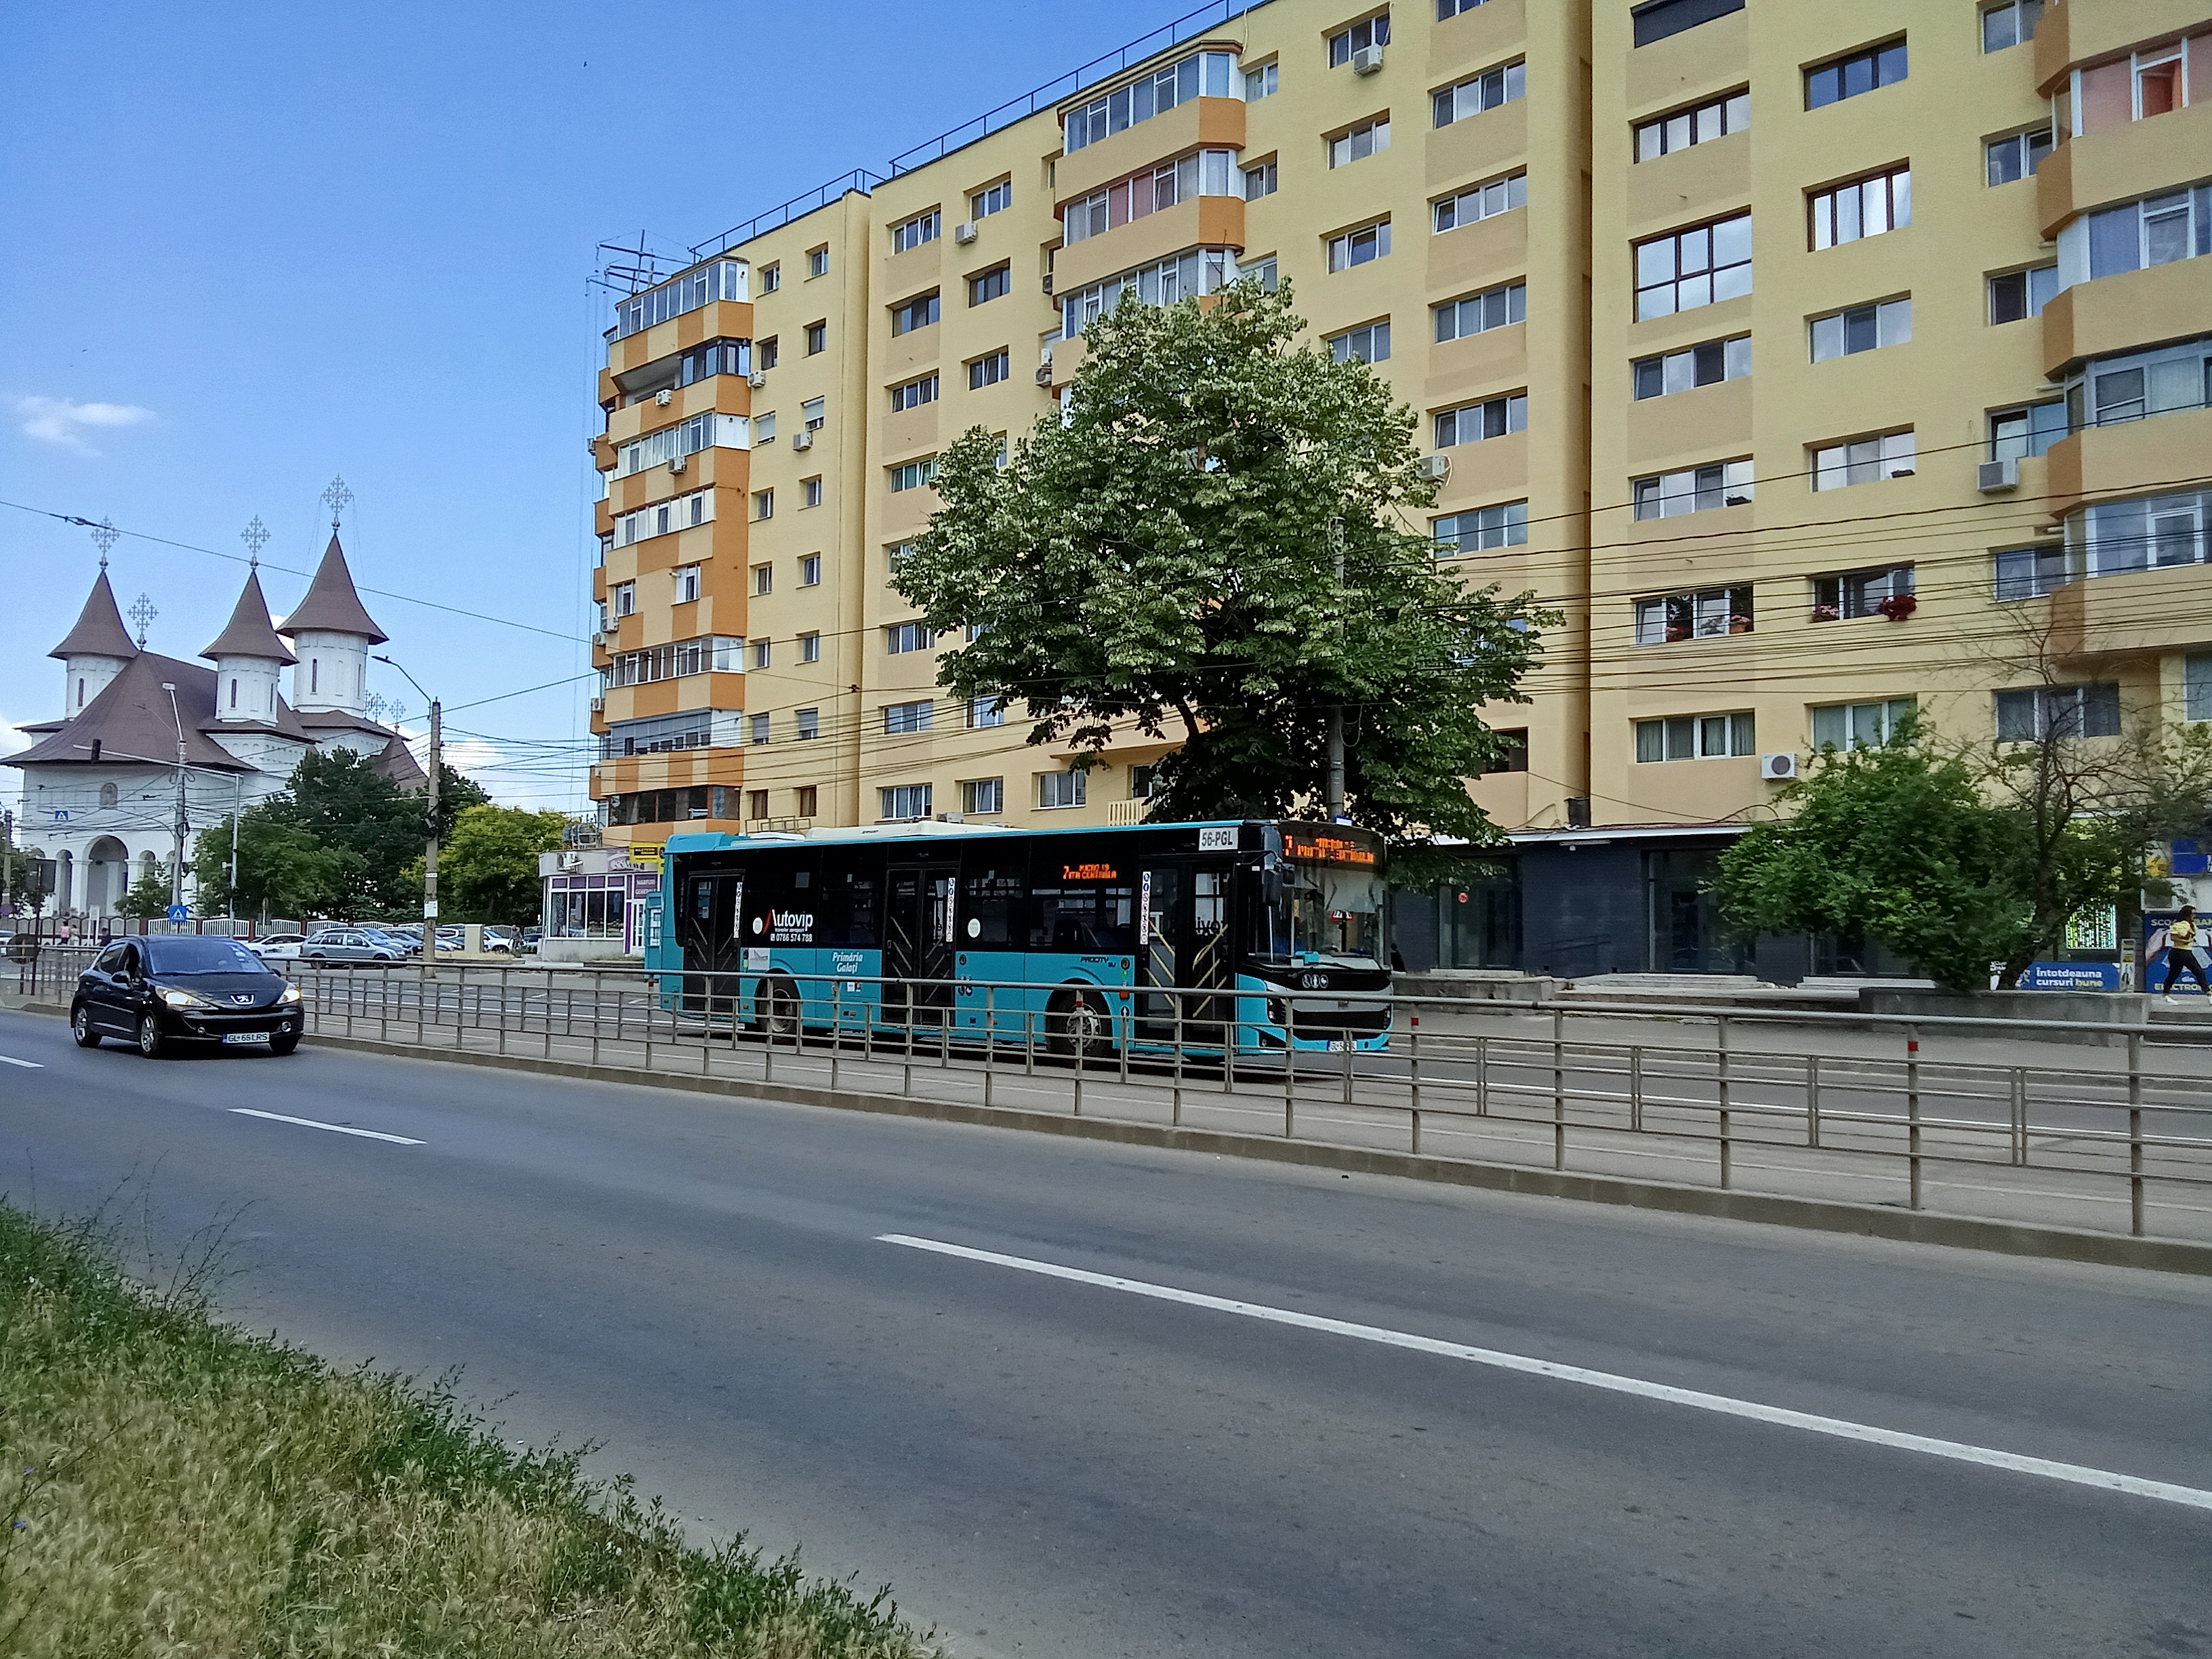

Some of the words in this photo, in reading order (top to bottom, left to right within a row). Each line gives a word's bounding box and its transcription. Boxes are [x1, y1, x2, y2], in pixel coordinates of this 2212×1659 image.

[1202, 830, 1233, 846] 56-PGL
[762, 906, 813, 931] Autovip
[790, 933, 801, 941] 574
[802, 933, 813, 942] 788
[2036, 978, 2074, 987] cursuri
[251, 1033, 268, 1041] LRS
